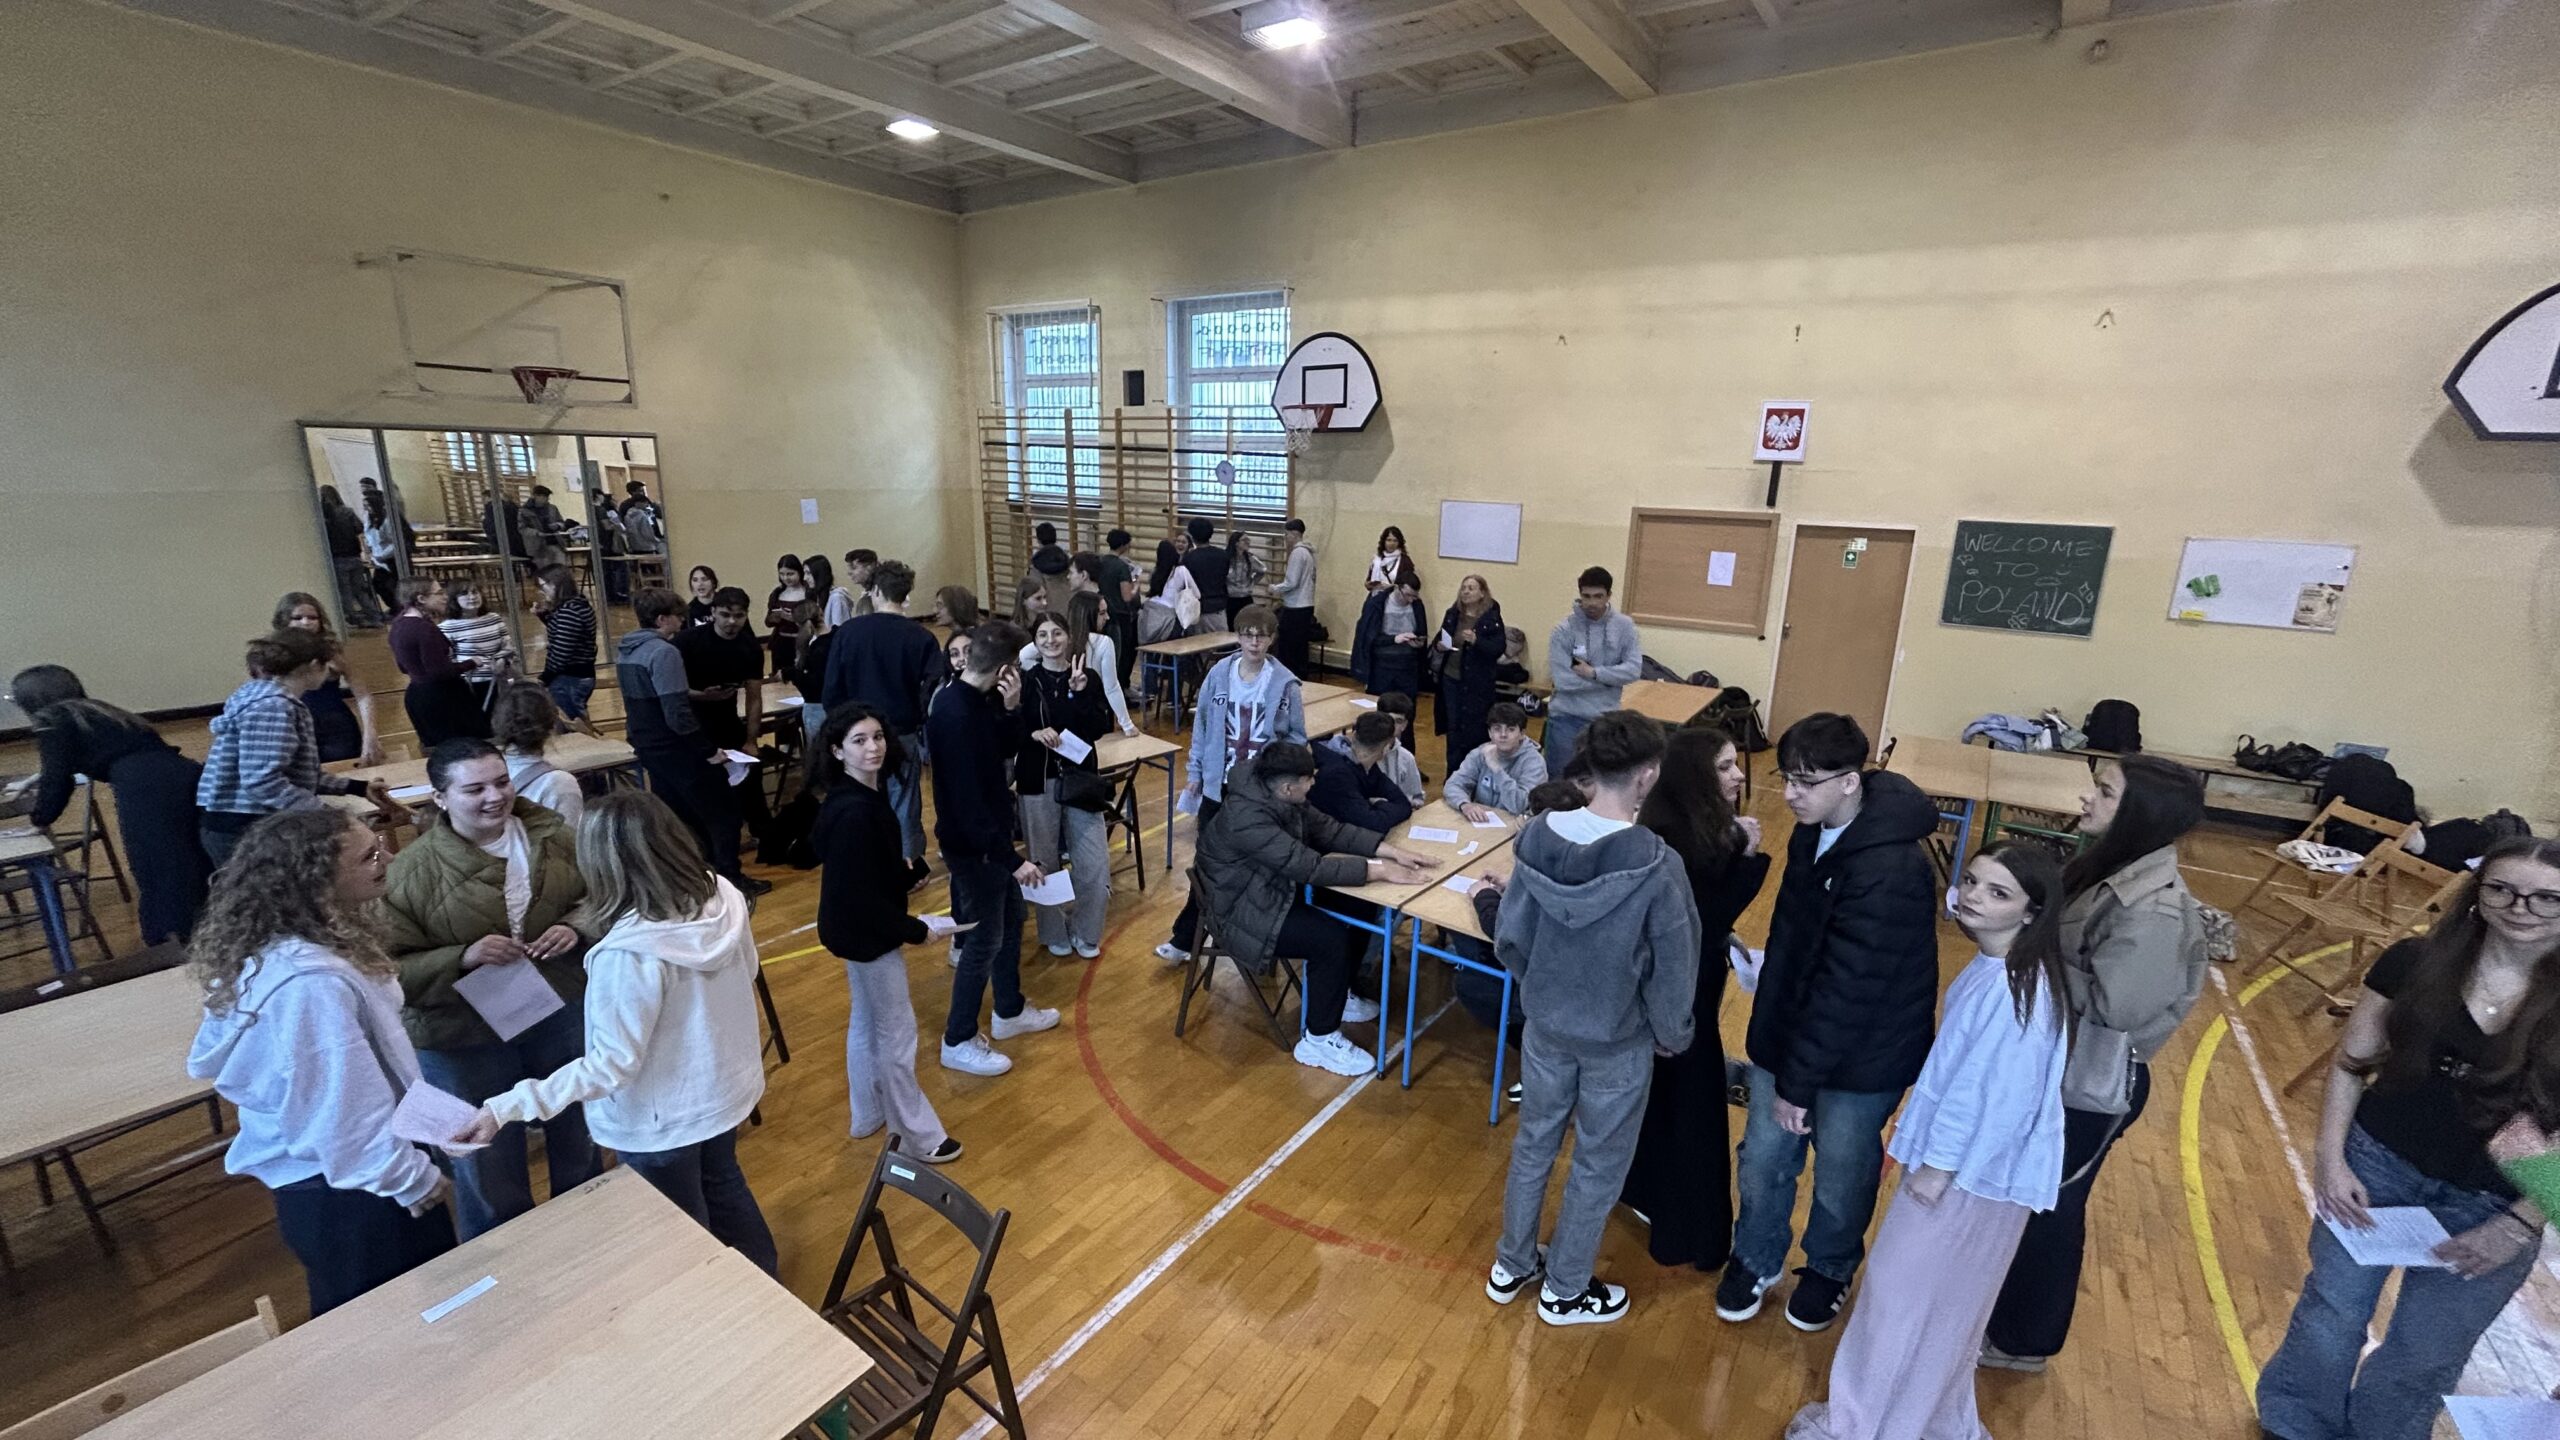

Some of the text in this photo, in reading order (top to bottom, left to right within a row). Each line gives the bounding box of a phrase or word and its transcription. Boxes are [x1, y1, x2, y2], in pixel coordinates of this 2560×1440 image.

[1964, 533, 2094, 557] WELCOME
[1995, 561, 2039, 577] TO
[1960, 579, 2085, 625] POLAND
